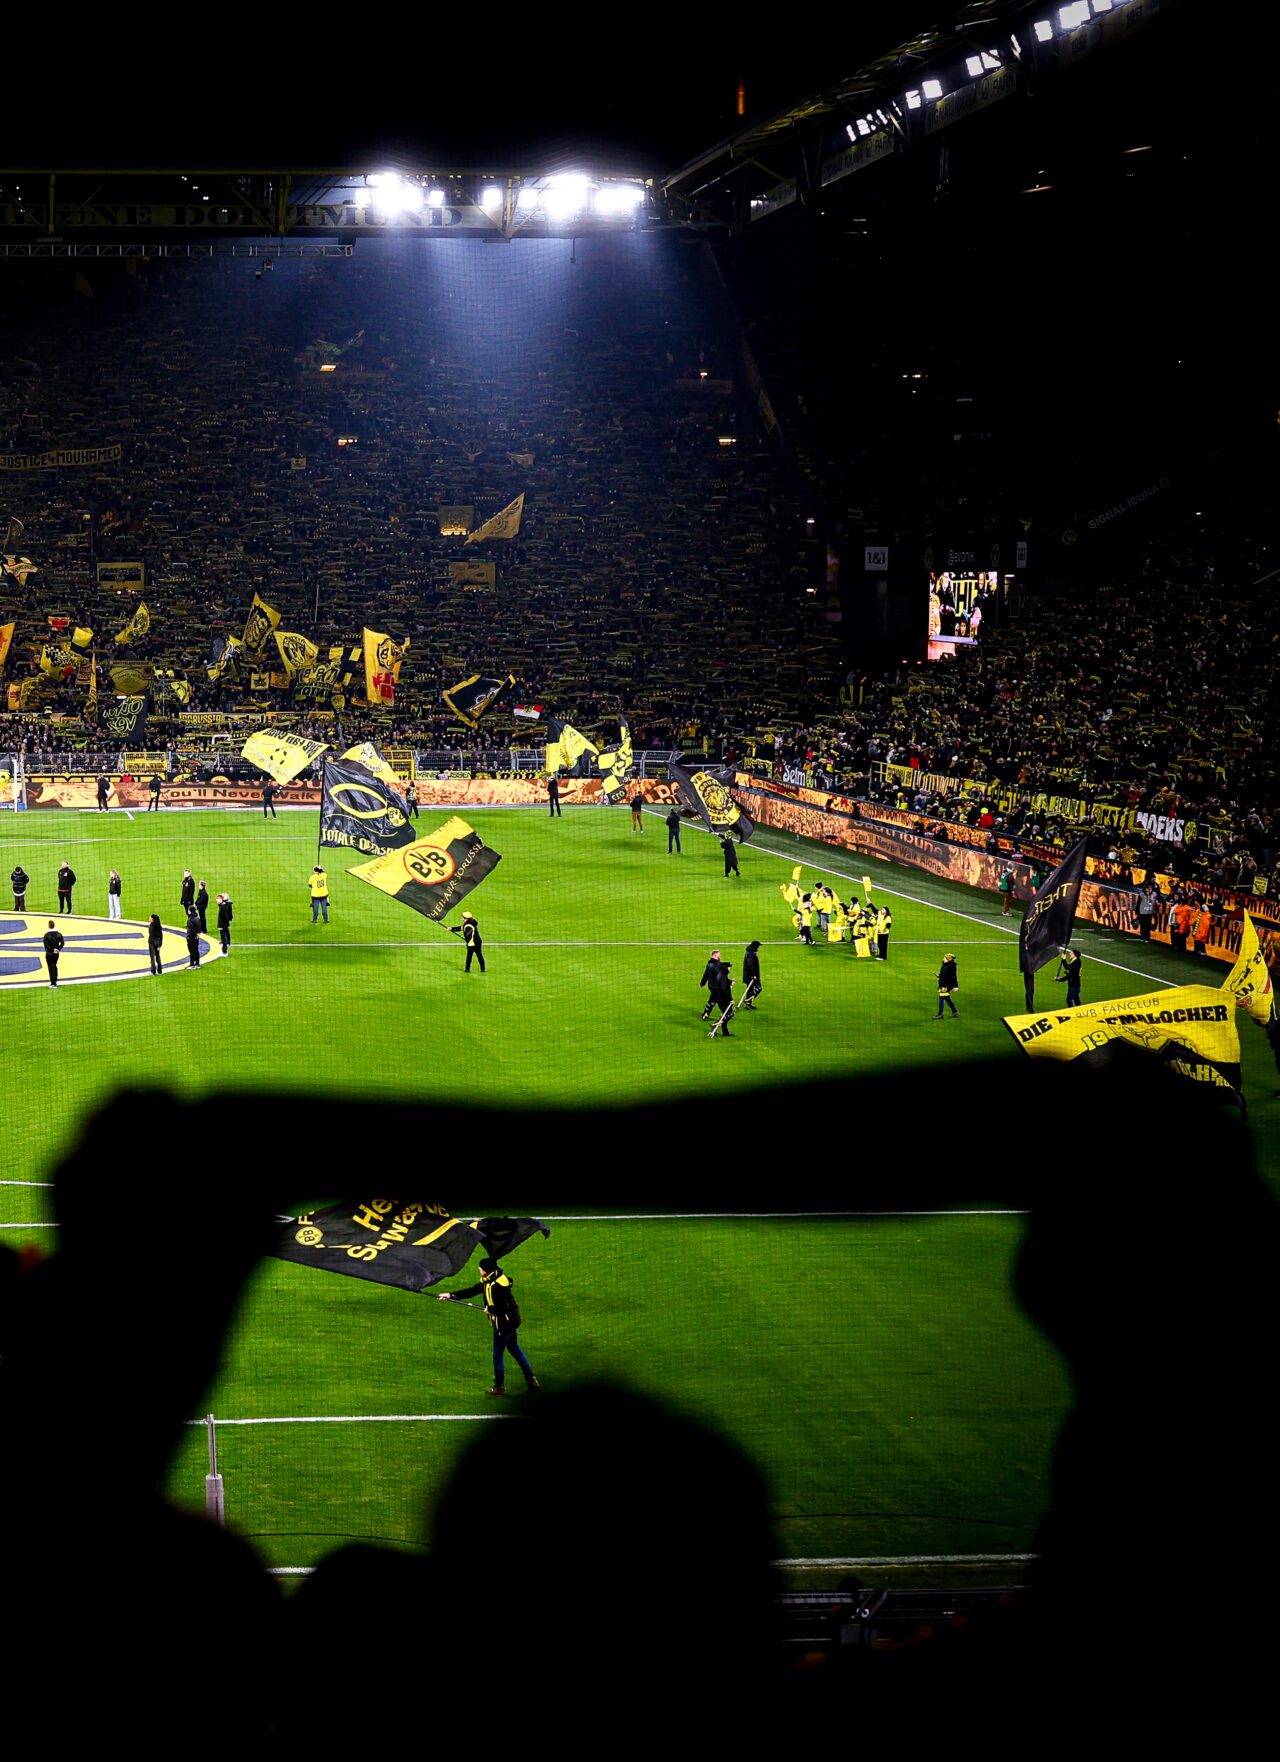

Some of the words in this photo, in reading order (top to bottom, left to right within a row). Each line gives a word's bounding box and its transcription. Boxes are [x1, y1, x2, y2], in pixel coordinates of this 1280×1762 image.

[1088, 503, 1127, 529] SIGNAL
[867, 552, 886, 564] 1&1
[783, 765, 806, 786] Selm
[214, 788, 263, 800] Neve
[322, 828, 357, 846] TOTALE
[409, 850, 448, 879] BVB
[1018, 1017, 1053, 1043] DIE
